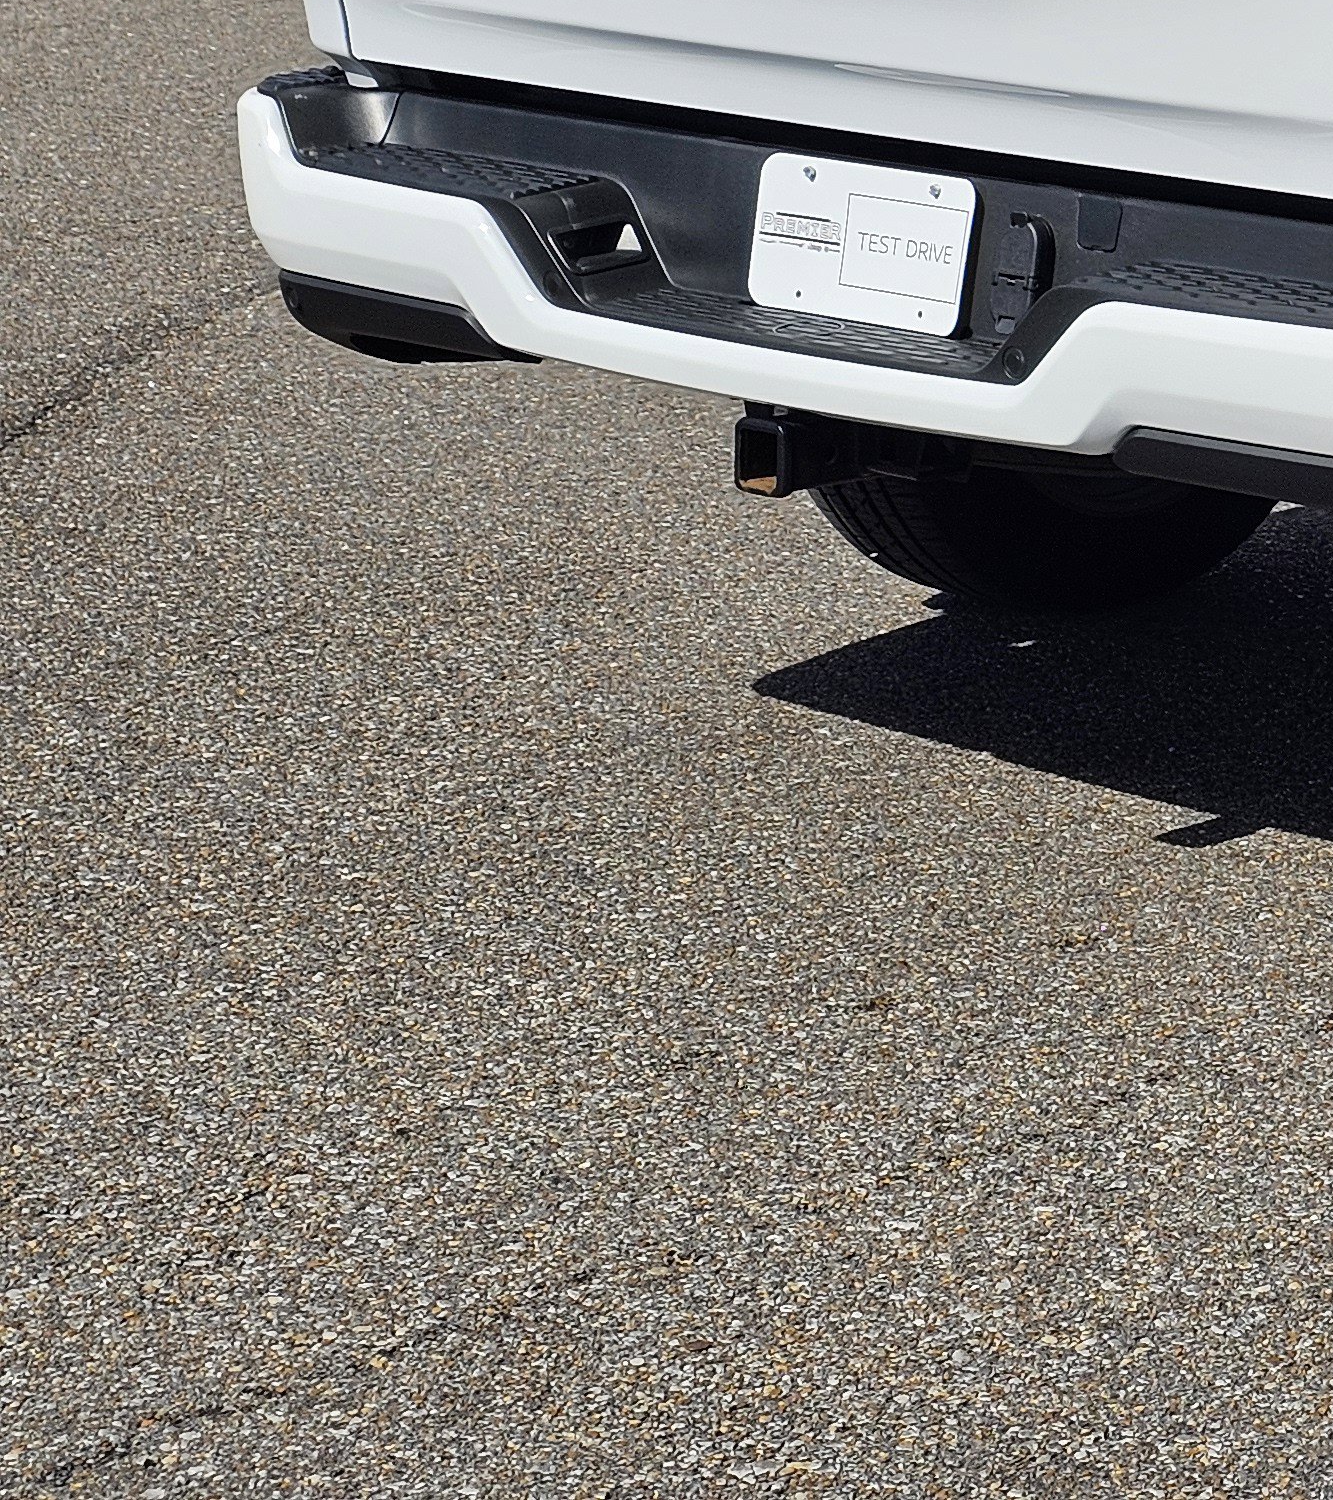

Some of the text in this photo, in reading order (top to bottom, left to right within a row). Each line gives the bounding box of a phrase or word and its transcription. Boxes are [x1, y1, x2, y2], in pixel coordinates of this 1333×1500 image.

[760, 211, 842, 242] PREMIER
[858, 231, 954, 265] TEST DRIVE
